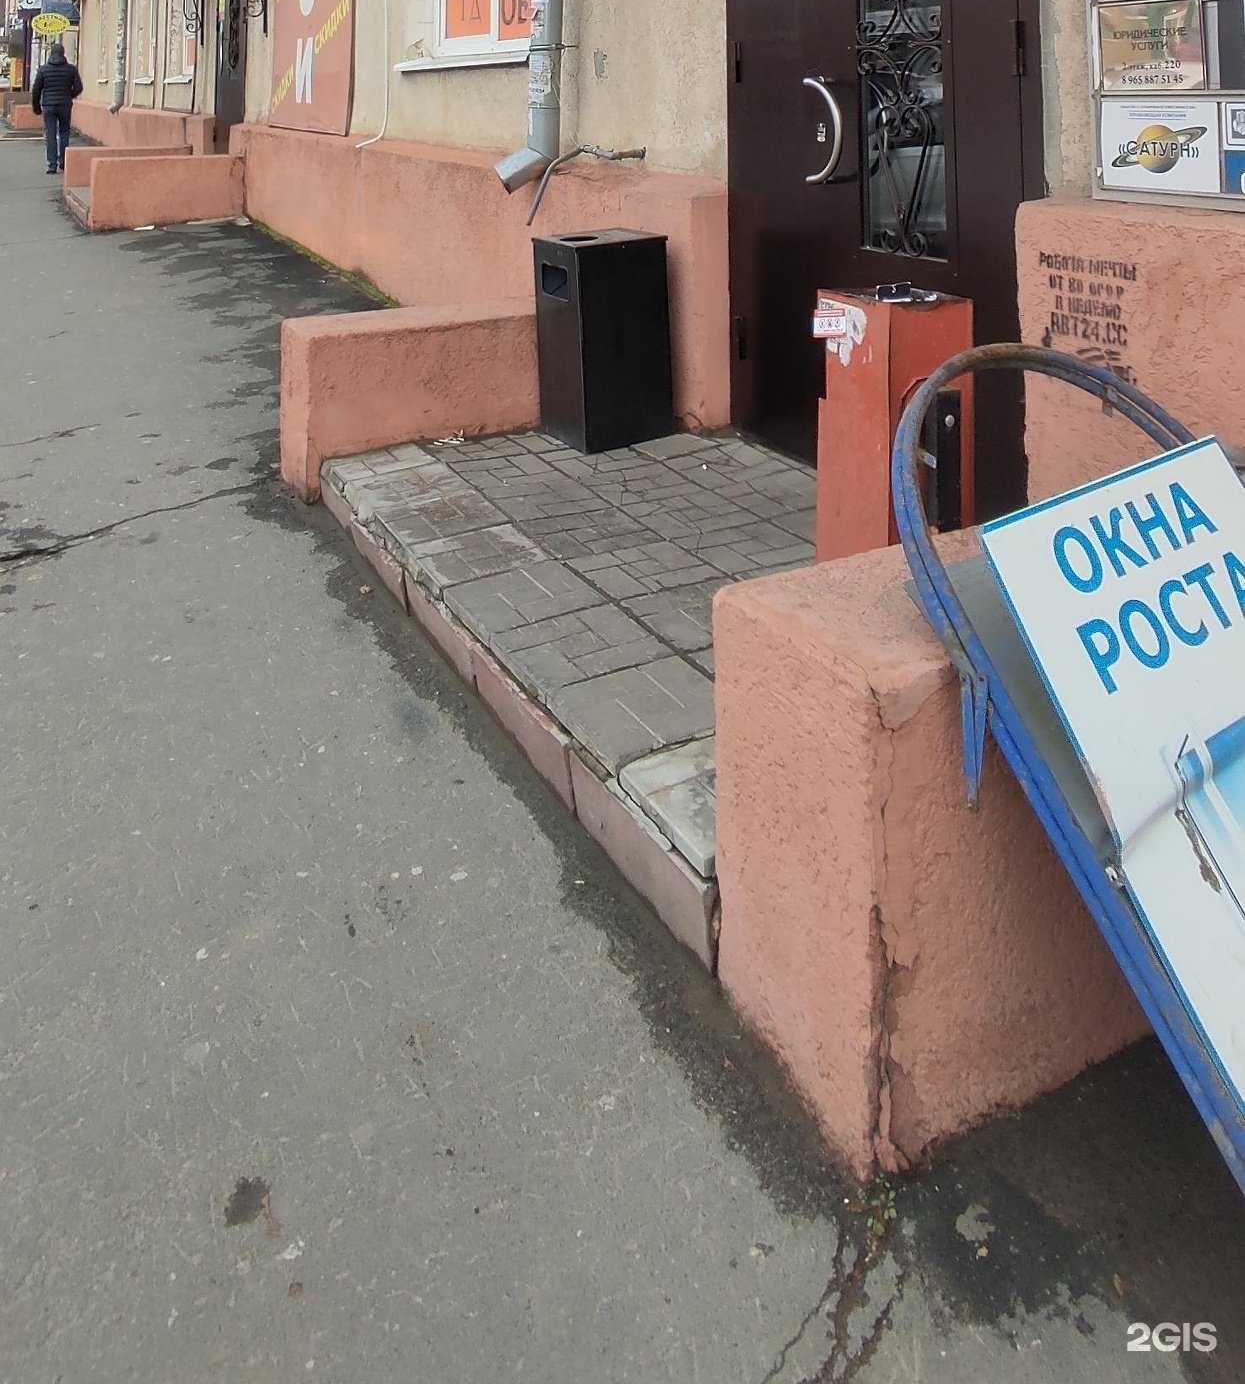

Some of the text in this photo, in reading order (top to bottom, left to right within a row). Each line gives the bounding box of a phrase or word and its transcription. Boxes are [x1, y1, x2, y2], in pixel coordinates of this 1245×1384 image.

[1113, 26, 1187, 40] ЮРИДИЧЕСКИЕ
[1131, 40, 1169, 51] УСЛУГИ
[1164, 60, 1181, 69] 220
[1121, 76, 1127, 85] 8
[1118, 140, 1200, 159] «САТУРН»
[1052, 481, 1219, 594] ОКНА
